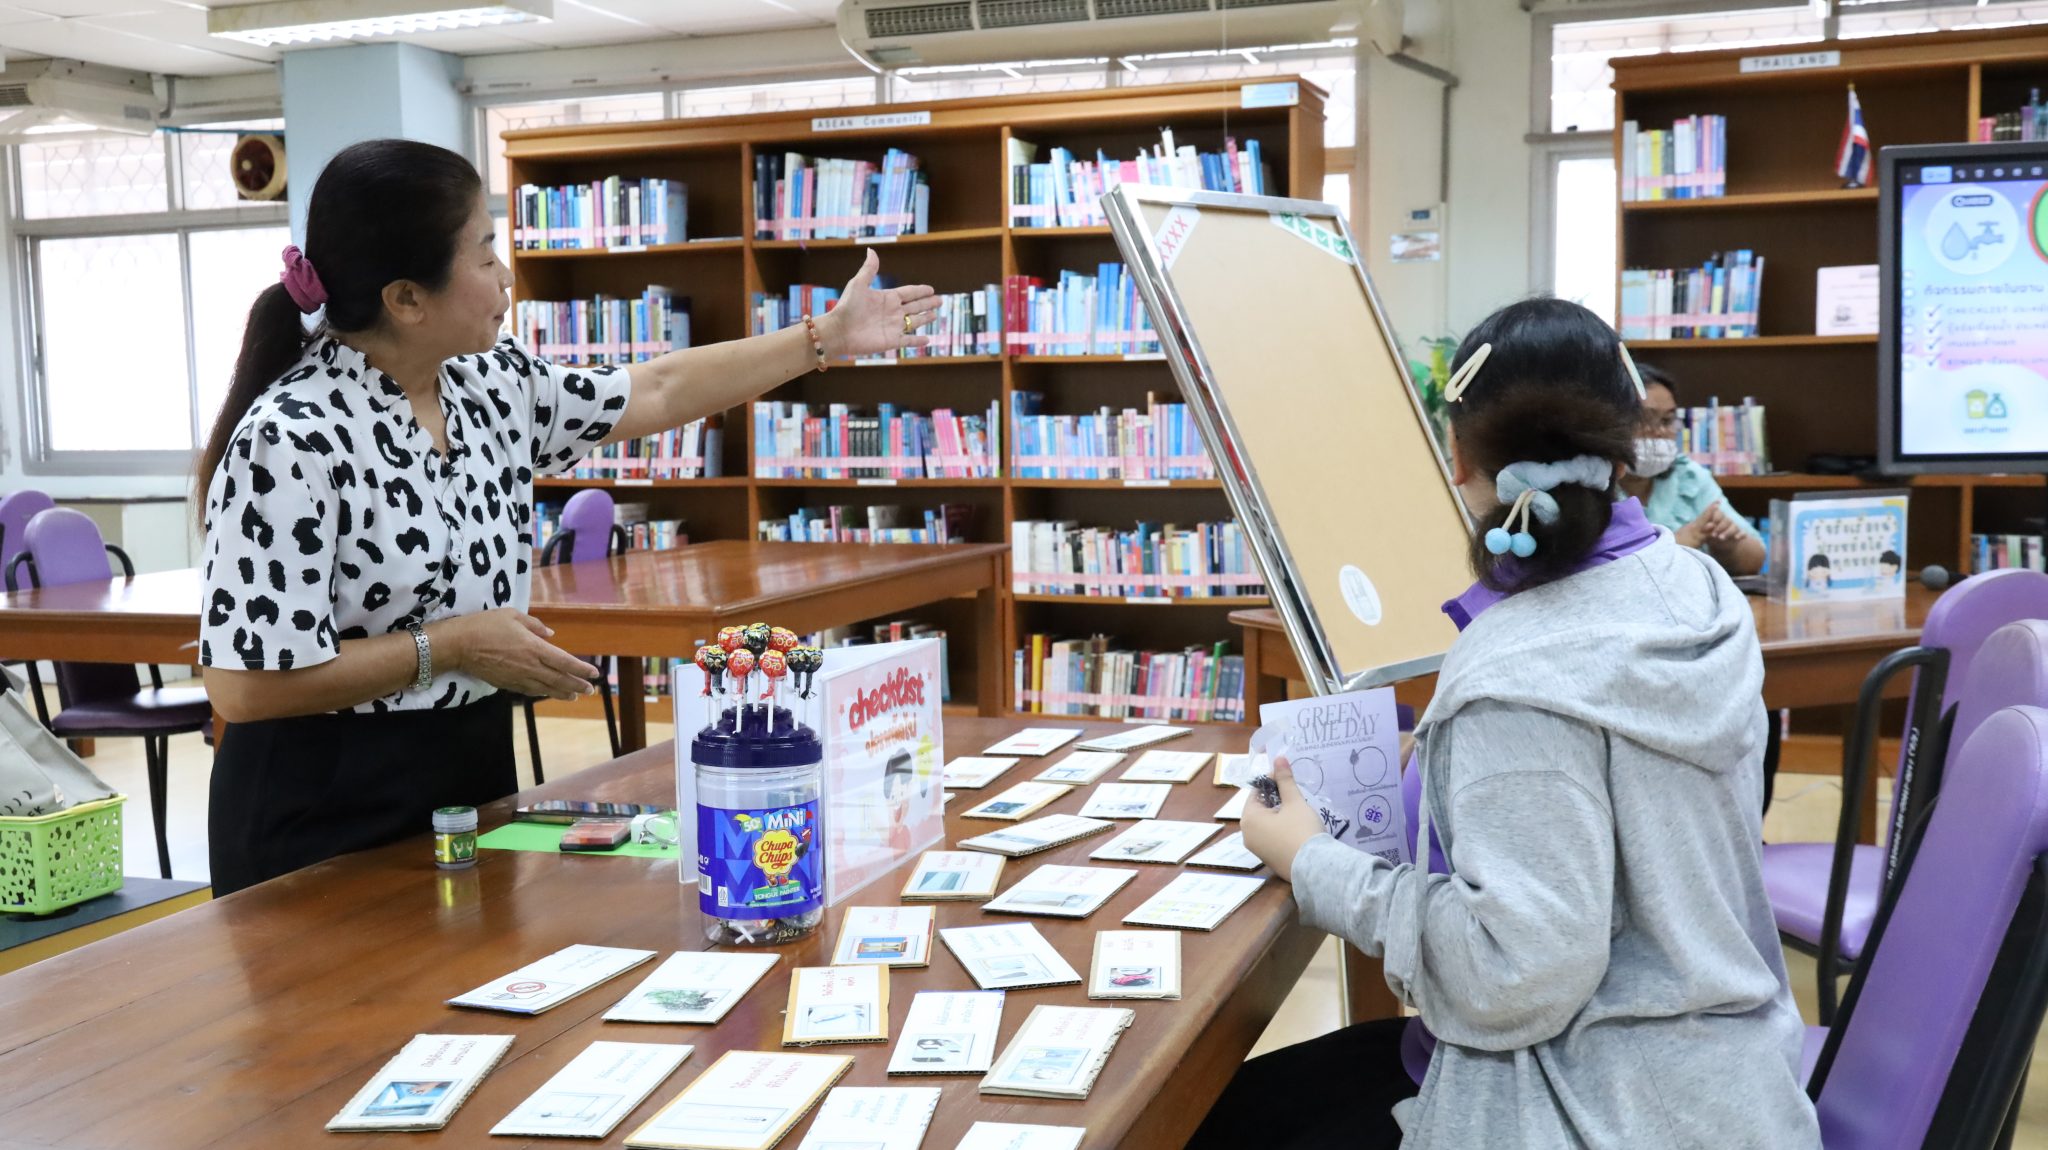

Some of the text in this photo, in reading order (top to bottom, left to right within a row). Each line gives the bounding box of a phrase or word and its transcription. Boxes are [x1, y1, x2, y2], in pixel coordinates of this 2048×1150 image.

[1753, 53, 1828, 68] THAILAND
[817, 114, 924, 129] ASEAN Community
[849, 667, 924, 730] checklist
[1297, 701, 1362, 728] GREEN
[1344, 713, 1380, 739] DAY
[761, 840, 793, 852] Chupa
[760, 850, 793, 868] Chups
